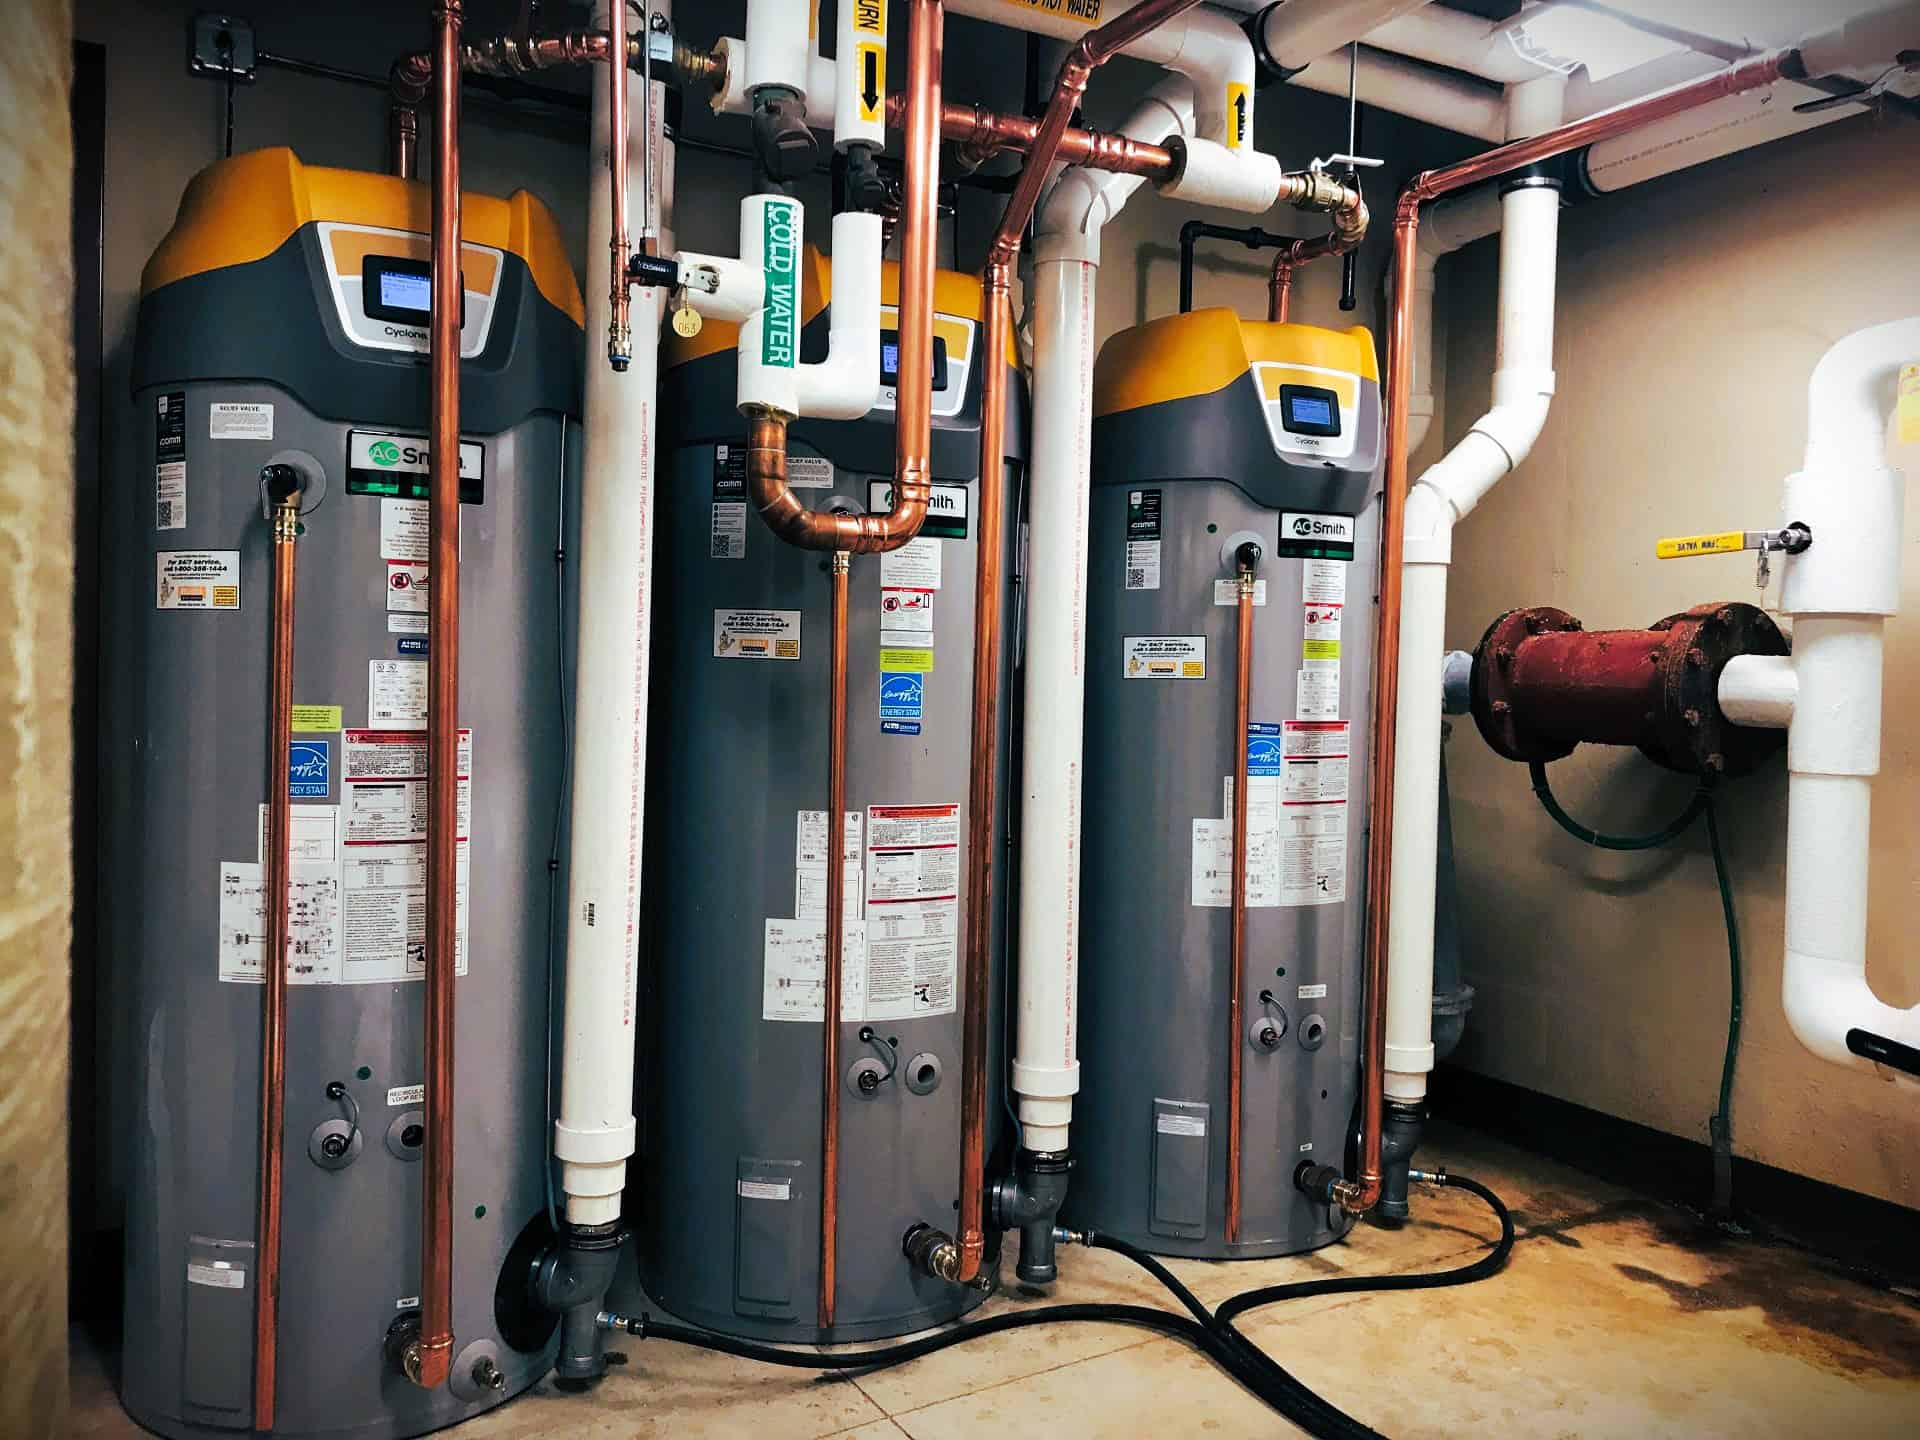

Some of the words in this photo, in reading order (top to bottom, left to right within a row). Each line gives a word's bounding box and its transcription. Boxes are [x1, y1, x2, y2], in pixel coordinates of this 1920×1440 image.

[858, 0, 880, 30] URN
[1067, 0, 1100, 20] WATER
[769, 207, 792, 272] COLD
[768, 284, 792, 361] WATER
[928, 494, 954, 509] mith
[1313, 521, 1345, 536] Smith
[305, 786, 326, 795] STAR
